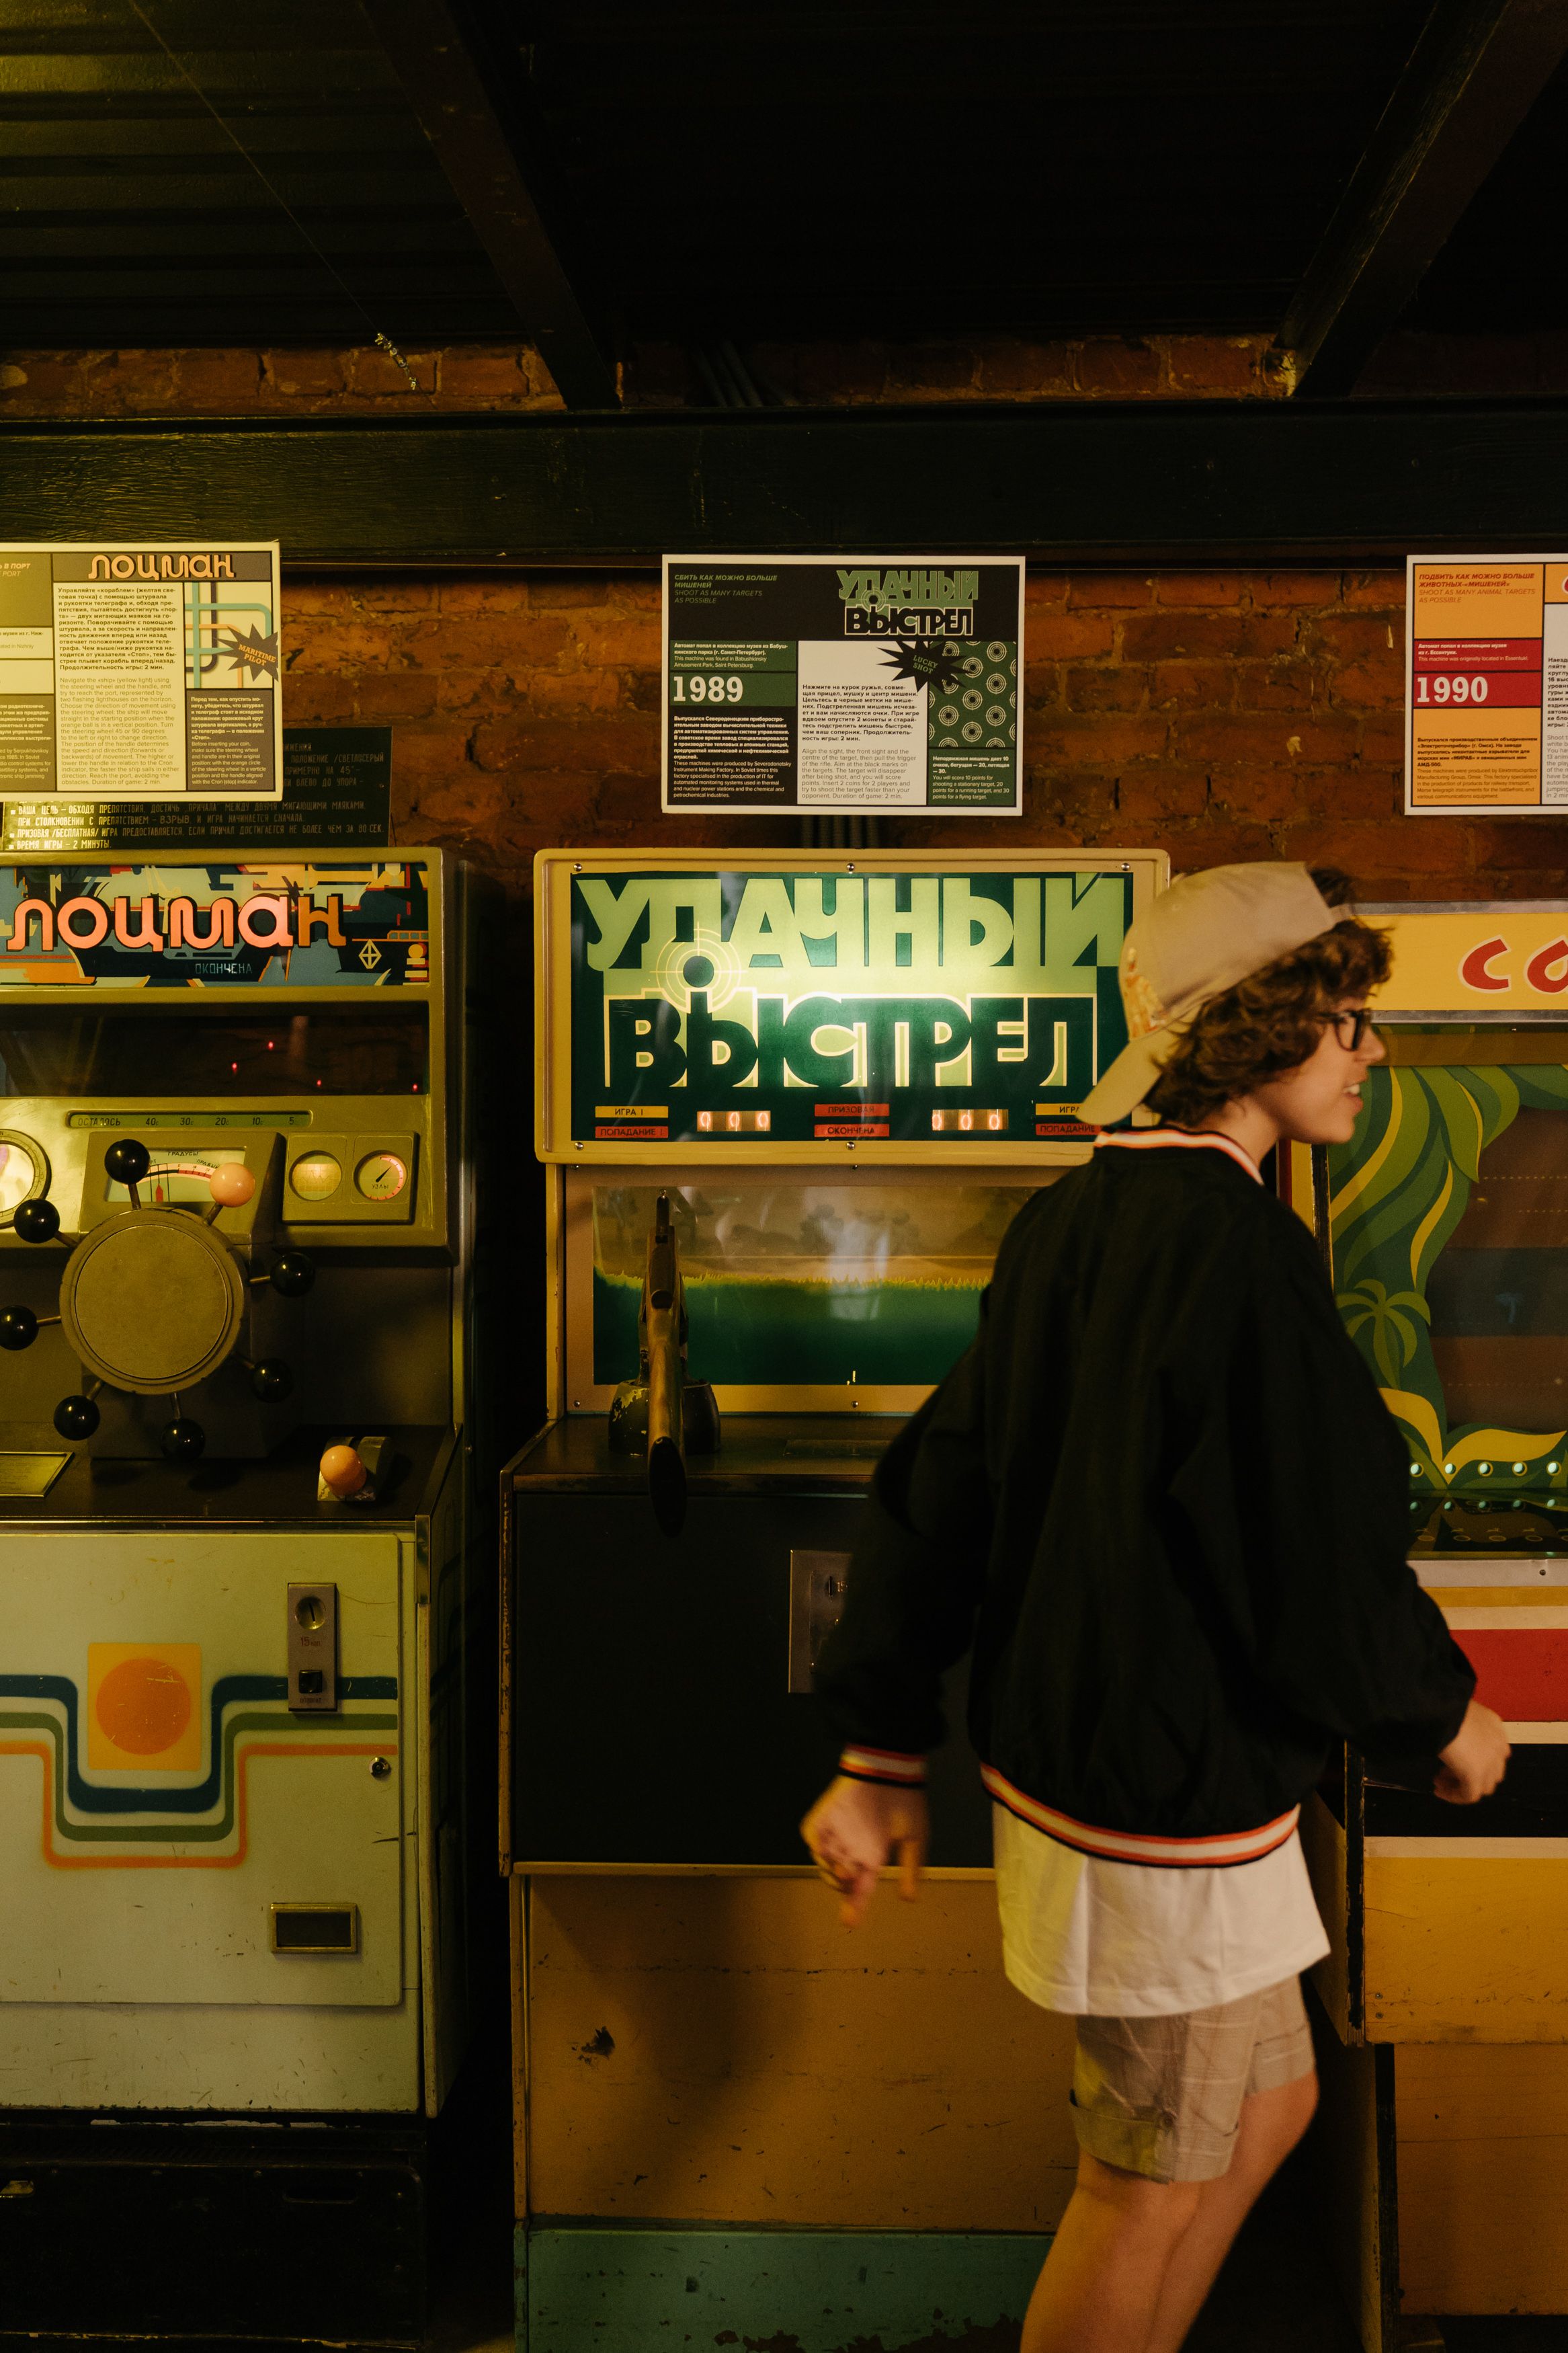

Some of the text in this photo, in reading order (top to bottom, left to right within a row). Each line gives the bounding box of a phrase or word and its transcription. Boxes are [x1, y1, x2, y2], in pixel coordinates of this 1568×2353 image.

[837, 570, 979, 600] УДАЧНЫЙ
[845, 604, 973, 635] ВЫСТРЕЛ
[238, 644, 276, 663] MARITIME
[244, 654, 266, 666] PILOT
[913, 655, 938, 668] LUCKY
[913, 663, 934, 674] SHOT
[673, 676, 743, 702] 1989
[1417, 676, 1488, 703] 1990
[291, 754, 328, 763] ПОЛОЖЕНИЕ
[285, 766, 320, 774] ПРИМЕРНО
[326, 766, 333, 774] НА
[296, 778, 317, 787] ВЛЕВО
[322, 778, 331, 787] ДО
[337, 778, 356, 786] УПОРА
[19, 805, 36, 814] ВАША
[41, 805, 58, 815] ЦЕЛЬ
[69, 805, 94, 814] ОБХОДЯ
[151, 803, 180, 813] ДОСТИЧЬ
[225, 802, 249, 811] МЕЖДУ
[254, 802, 277, 811] ДВУМЯ
[282, 801, 327, 811] МИГАЮЩИМИ
[18, 817, 30, 826] ПРИ
[35, 817, 84, 826] СТОЛКНОВЕНИИ
[89, 817, 93, 825] С
[98, 816, 149, 825] ПРЕПЯТСТВИЕМ
[197, 815, 202, 823] И
[207, 814, 223, 823] ИГРА
[229, 813, 269, 823] НАЧИНАЕТСЯ
[17, 828, 49, 838] ПРИЗОВАЯ
[101, 828, 118, 837] ИГРА
[189, 826, 205, 835] ЕСЛИ
[210, 826, 235, 834] ПРИЧАЛ
[239, 826, 284, 835] ДОСТИГАЕТСЯ
[289, 825, 297, 834] НЕ
[302, 825, 322, 834] БОЛЕЕ
[328, 825, 341, 833] ЧЕМ
[346, 824, 354, 833] ЗА
[17, 840, 112, 850] ВРЕМЯ ИГРЫ 2 МИНУТЫ.
[578, 872, 1125, 971] УДАЧНЫЙ
[195, 961, 253, 975] ОКОНЧЕНА
[604, 987, 1098, 1088] ВЫСТРЕЛ
[301, 1636, 310, 1646] 15
